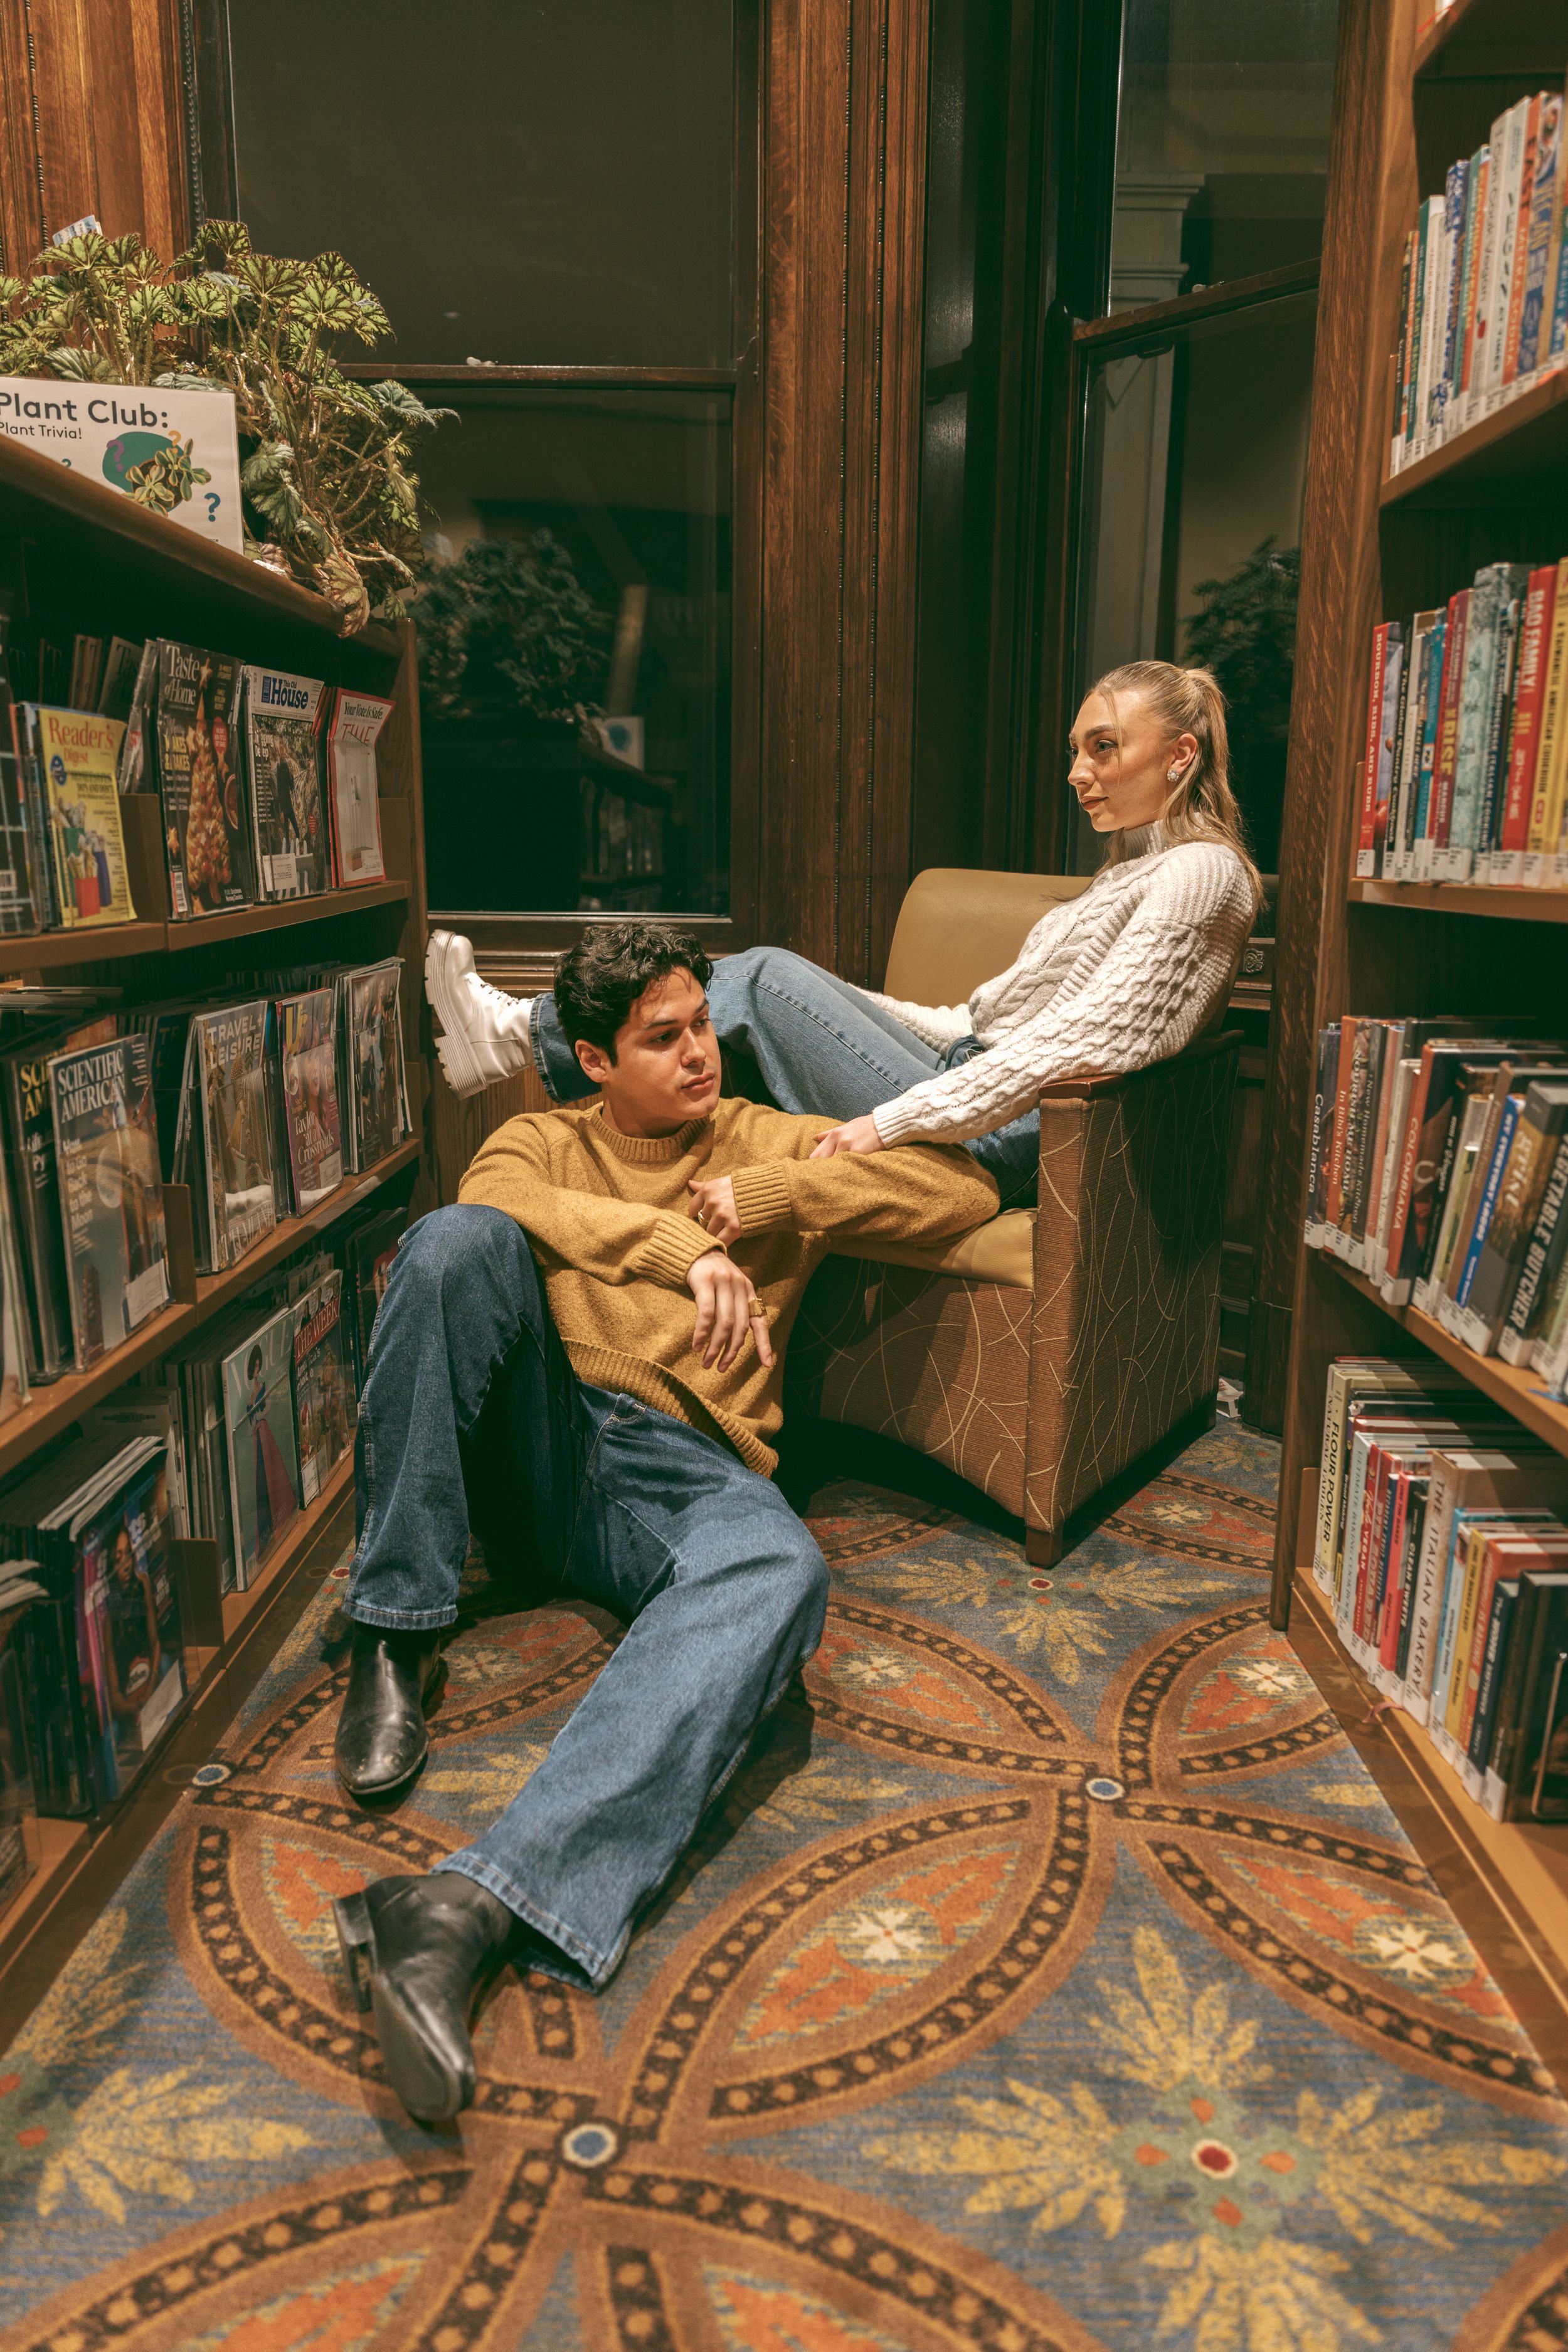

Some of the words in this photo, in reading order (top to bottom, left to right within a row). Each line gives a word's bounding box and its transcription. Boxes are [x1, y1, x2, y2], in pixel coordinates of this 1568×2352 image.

[1485, 188, 1496, 235] Cook
[1479, 242, 1491, 302] Vegan
[1505, 299, 1519, 366] SODHA
[0, 393, 77, 421] Plant
[88, 400, 168, 428] Club:
[0, 421, 34, 436] Plant
[38, 425, 82, 439] Trivia!
[166, 645, 200, 681] Taste
[1371, 633, 1383, 702] BOURBON,
[1519, 628, 1540, 686] FAMILY
[169, 678, 196, 705] Home
[271, 677, 309, 709] House
[344, 702, 356, 716] Your
[356, 704, 366, 717] Vote
[366, 706, 372, 718] Is
[48, 717, 114, 751] Reader's
[342, 723, 374, 743] TIME
[1369, 705, 1378, 742] RIBS,
[1397, 695, 1406, 735] Global
[1544, 690, 1557, 740] AMERICAN
[64, 748, 88, 767] Digest
[1367, 746, 1375, 773] AND
[1393, 739, 1402, 783] Pantry
[1439, 720, 1456, 775] RISE
[1364, 776, 1373, 812] RUBS
[1388, 787, 1398, 843] Cookbook
[58, 1046, 125, 1095] SCIENTIFIC
[209, 1033, 262, 1069] LEISURE
[61, 1074, 126, 1124] AMERICAN
[1338, 1090, 1346, 1103] In
[1347, 1050, 1362, 1119] NOURISH
[1363, 1079, 1373, 1106] New
[294, 1111, 316, 1136] Taylor
[1307, 1093, 1323, 1193] Casablanca
[1335, 1106, 1345, 1136] Bibi's
[1345, 1123, 1355, 1145] ME
[1357, 1109, 1370, 1175] Homemade
[298, 1129, 335, 1165] Crossroads
[1331, 1140, 1342, 1184] Kitchen
[1485, 1136, 1509, 1198] EVERYDAY
[1340, 1149, 1352, 1194] HOME
[1392, 1116, 1419, 1229] COLOMBIANA
[1352, 1179, 1364, 1223] Kitchen
[1510, 1241, 1547, 1329] BUTCHER
[295, 1329, 312, 1360] THE
[314, 1298, 339, 1338] WEEK
[231, 1320, 290, 1398] VOGUE
[1322, 1395, 1334, 1464] NATURAL
[1327, 1421, 1338, 1475] FLOUR
[1352, 1450, 1364, 1505] ULTIMATE
[1431, 1480, 1445, 1515] THE
[1323, 1479, 1335, 1542] POWER
[1371, 1500, 1383, 1538] PIE
[1393, 1518, 1401, 1544] BAKES
[1348, 1517, 1358, 1555] BAKING
[1359, 1530, 1369, 1569] VEGAN
[1379, 1533, 1388, 1557] FRUIT
[1404, 1542, 1416, 1581] CLEAN
[1421, 1527, 1439, 1606] ITALIAN
[1342, 1557, 1354, 1619] COOKBOOK
[1362, 1540, 1379, 1641] SQUARED
[1399, 1583, 1411, 1627] SWEETS
[1411, 1616, 1429, 1688] BAKERY
[1471, 1623, 1485, 1666] BAKING
